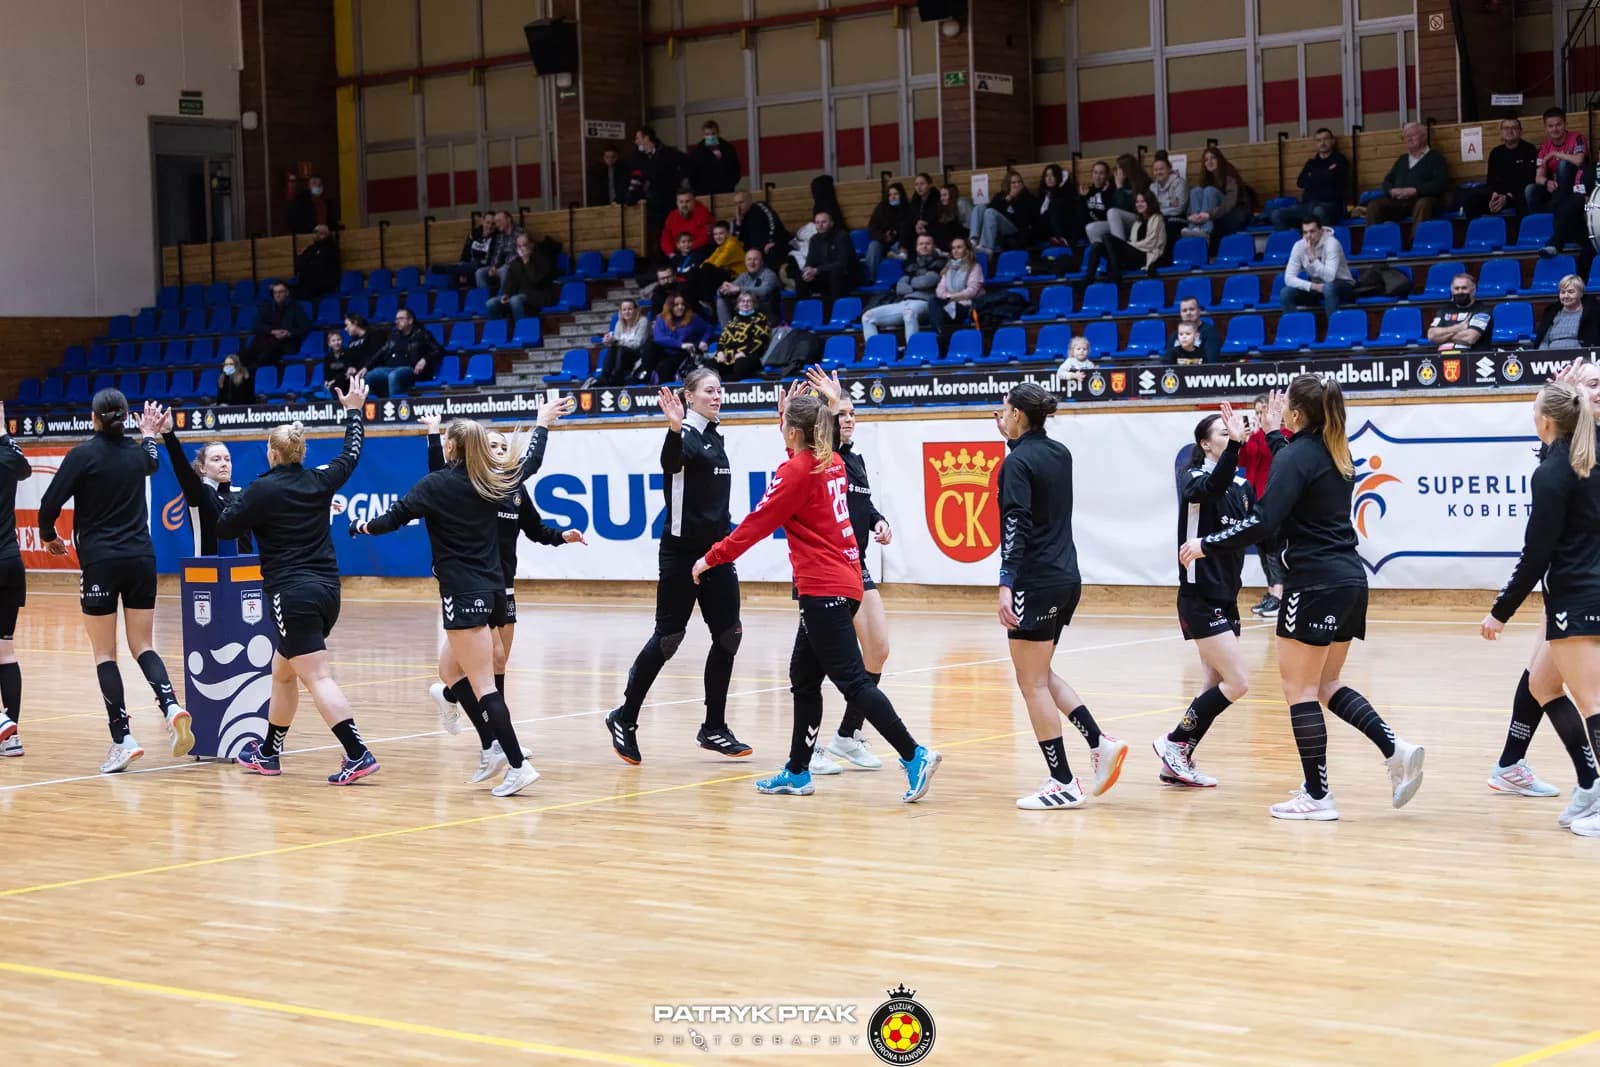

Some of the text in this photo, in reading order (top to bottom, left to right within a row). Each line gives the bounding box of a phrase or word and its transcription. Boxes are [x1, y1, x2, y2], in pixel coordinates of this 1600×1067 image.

[977, 80, 989, 90] A
[588, 128, 599, 137] B
[1467, 143, 1476, 153] A
[976, 188, 984, 197] A
[1185, 361, 1410, 388] www.koronndball.pl
[1417, 475, 1527, 495] SUPERLI
[1448, 503, 1533, 517] KOBIET
[934, 490, 993, 548] CK
